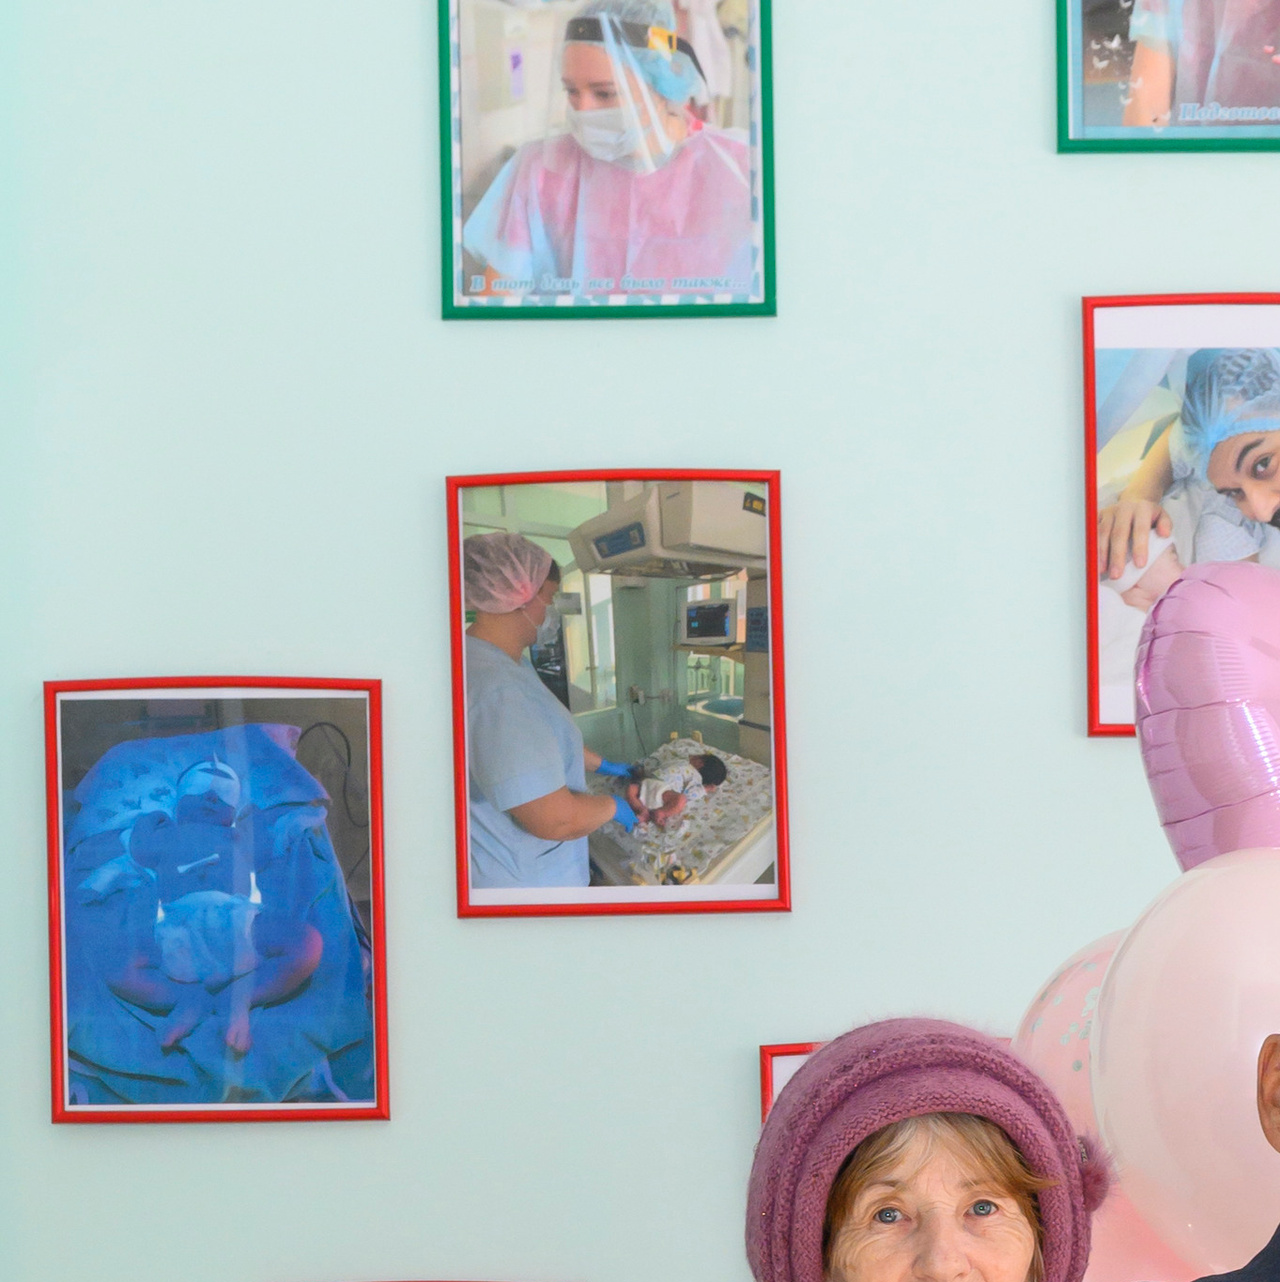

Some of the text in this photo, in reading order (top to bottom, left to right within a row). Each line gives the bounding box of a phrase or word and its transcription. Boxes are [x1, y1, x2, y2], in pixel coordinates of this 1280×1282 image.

[470, 275, 485, 291] В
[492, 278, 534, 291] тот
[540, 274, 581, 291] день
[620, 273, 666, 290] было
